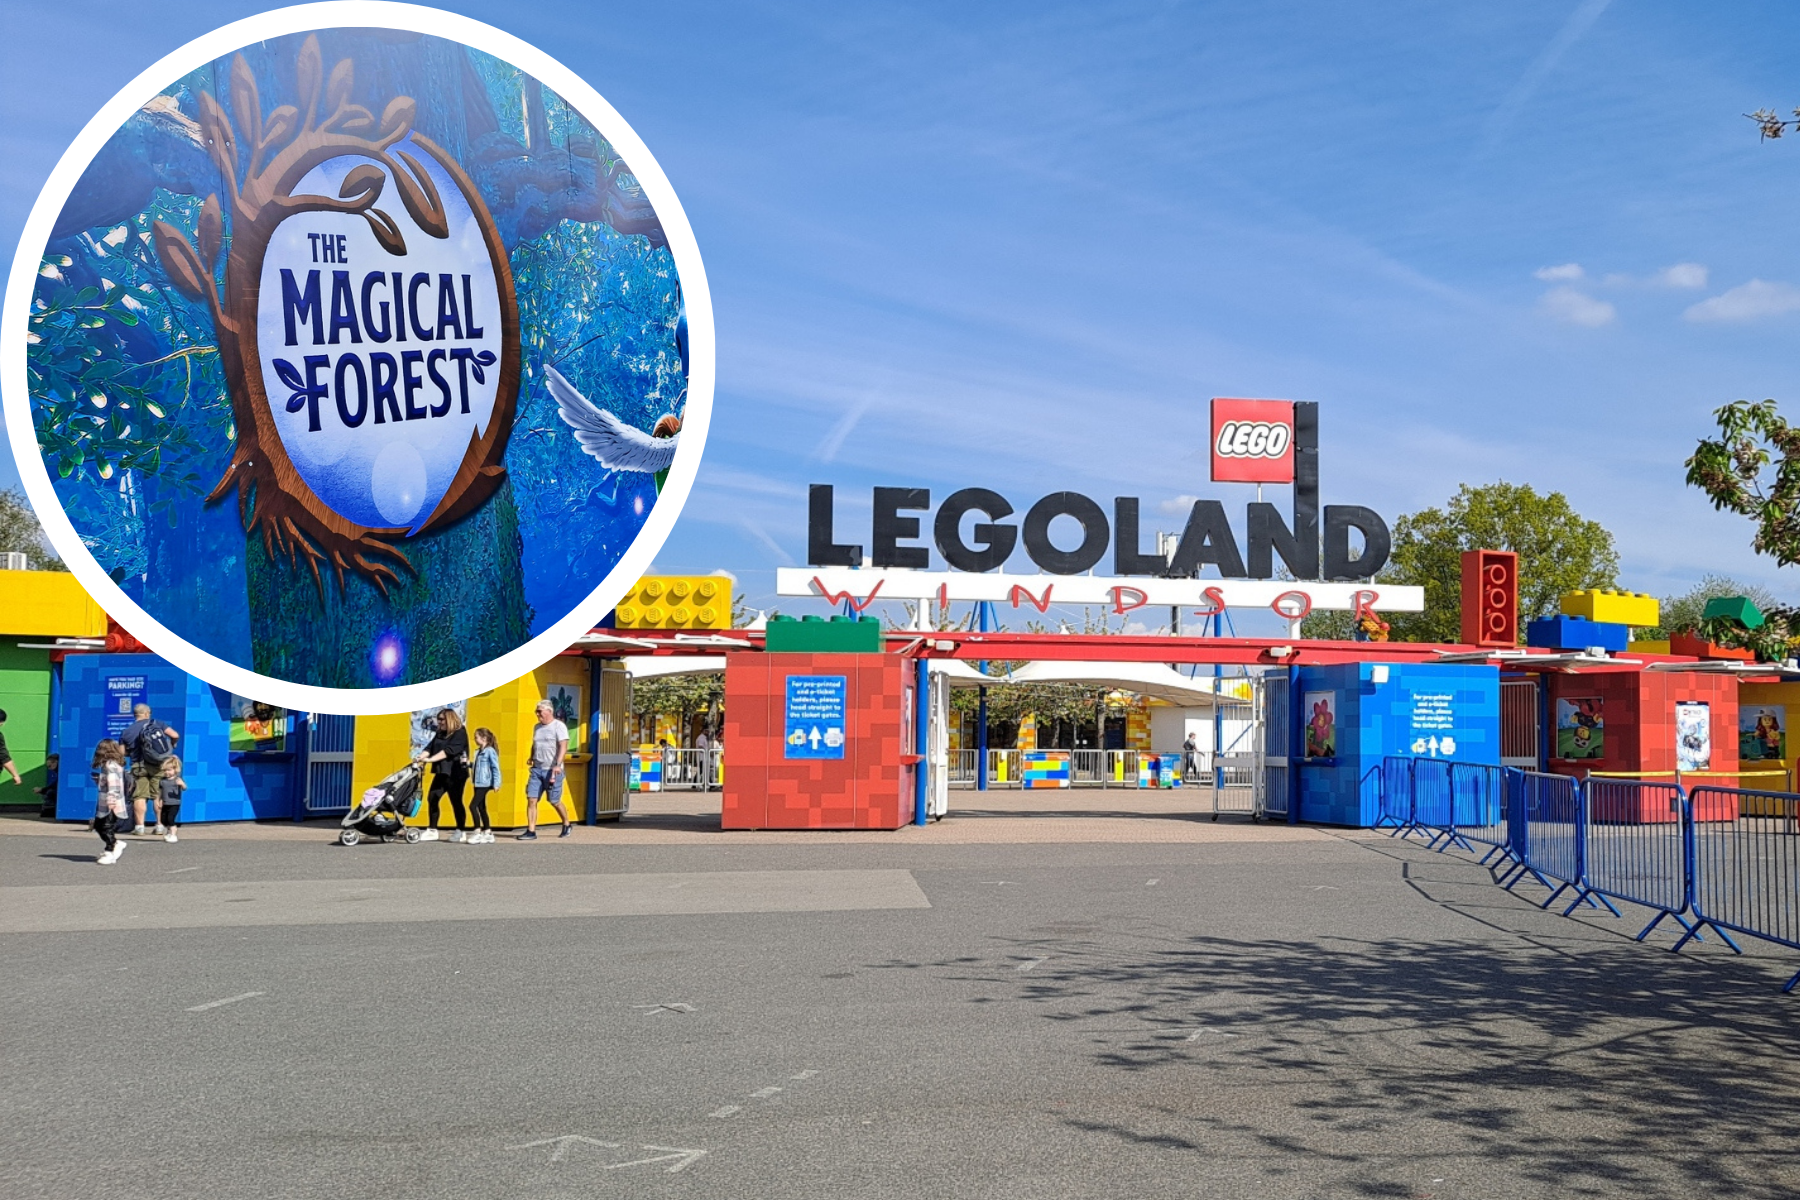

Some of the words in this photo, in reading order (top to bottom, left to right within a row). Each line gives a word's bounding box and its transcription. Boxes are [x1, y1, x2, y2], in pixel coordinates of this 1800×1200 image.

[307, 233, 348, 263] THE
[279, 268, 484, 346] MAGICAL
[303, 347, 476, 432] FOREST
[1216, 420, 1291, 459] LEGO
[808, 402, 1391, 581] LEGOLAND
[812, 575, 1380, 622] WINDSOR
